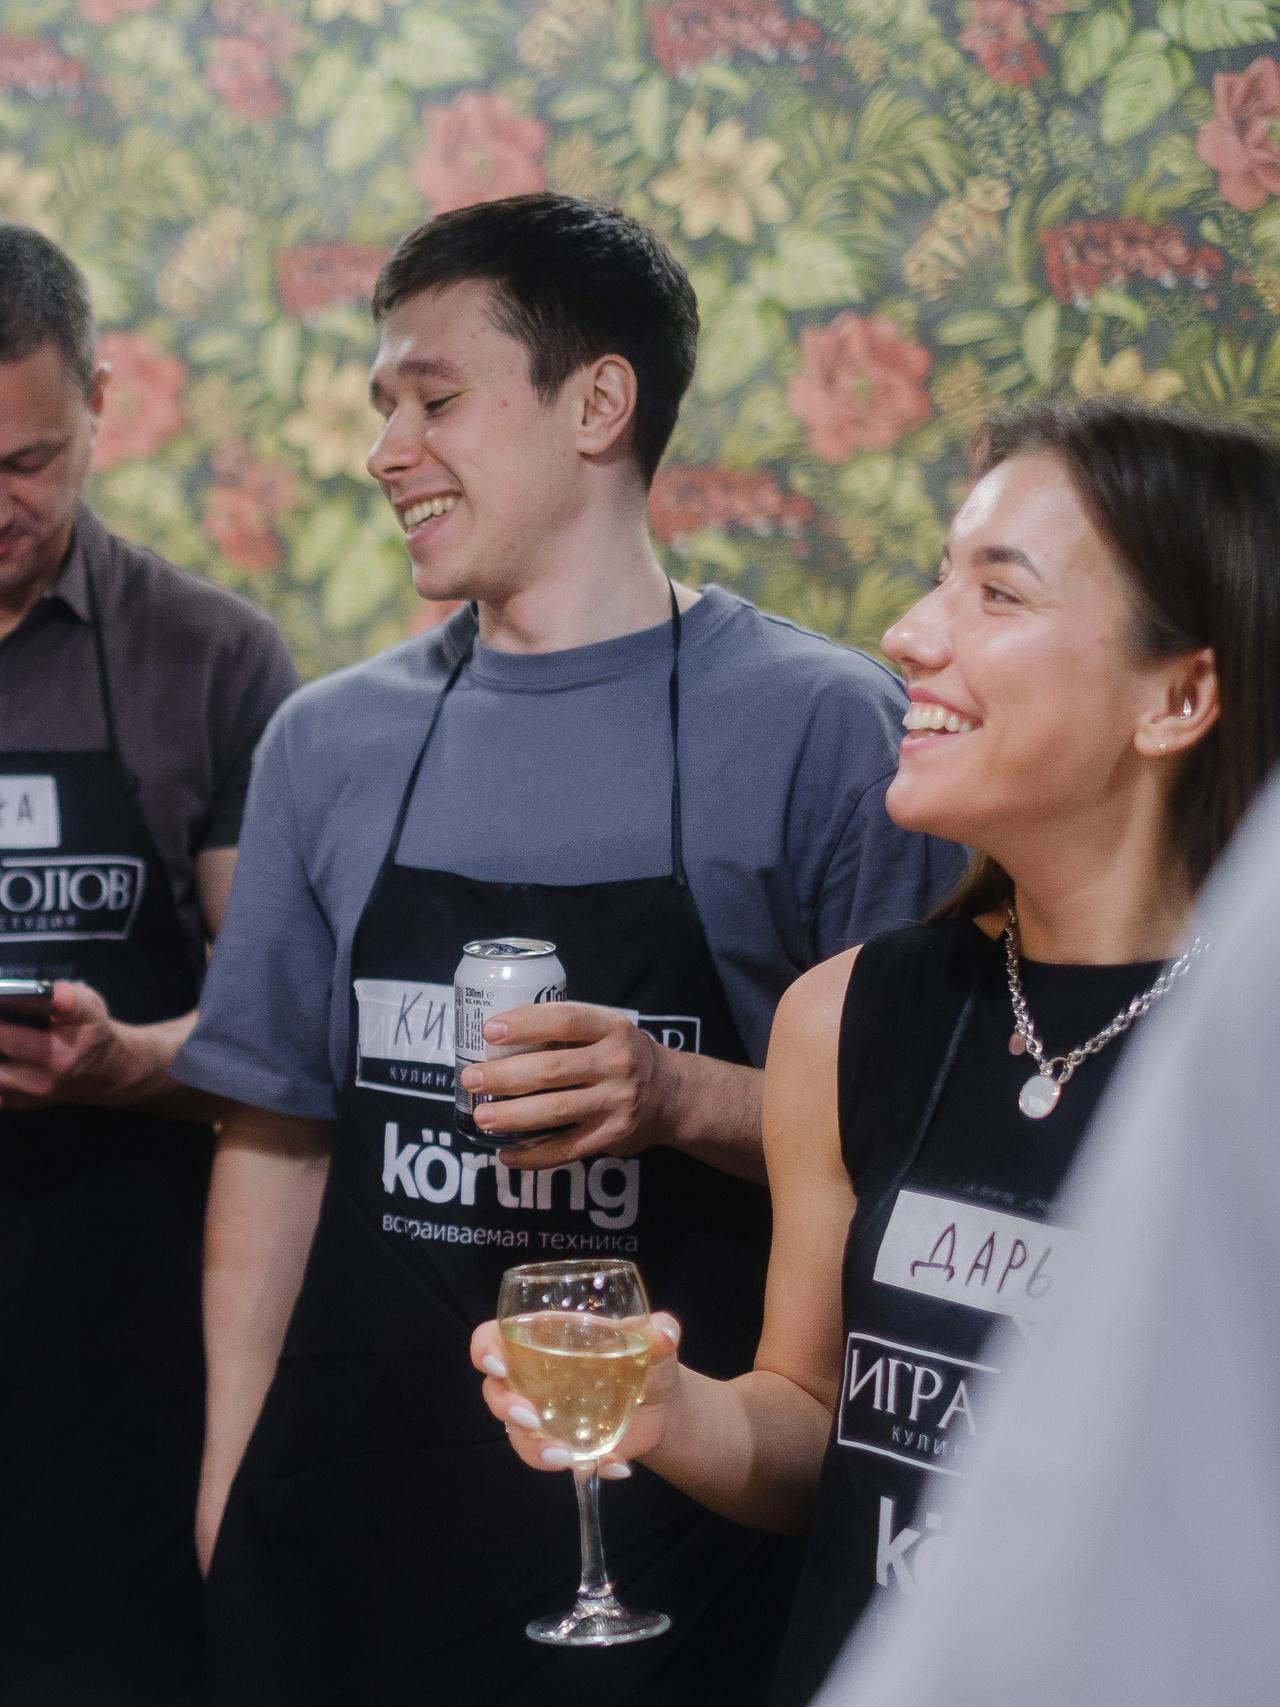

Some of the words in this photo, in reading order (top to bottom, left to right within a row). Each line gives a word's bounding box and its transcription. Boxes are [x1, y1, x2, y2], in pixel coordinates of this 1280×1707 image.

[394, 991, 455, 1051] КИ
[389, 1066, 457, 1089] КУЛИН
[382, 1213, 529, 1248] встраиваемая
[538, 1231, 638, 1253] техника
[910, 1222, 1054, 1298] ДАРЬ
[849, 1349, 978, 1437] ИГРА
